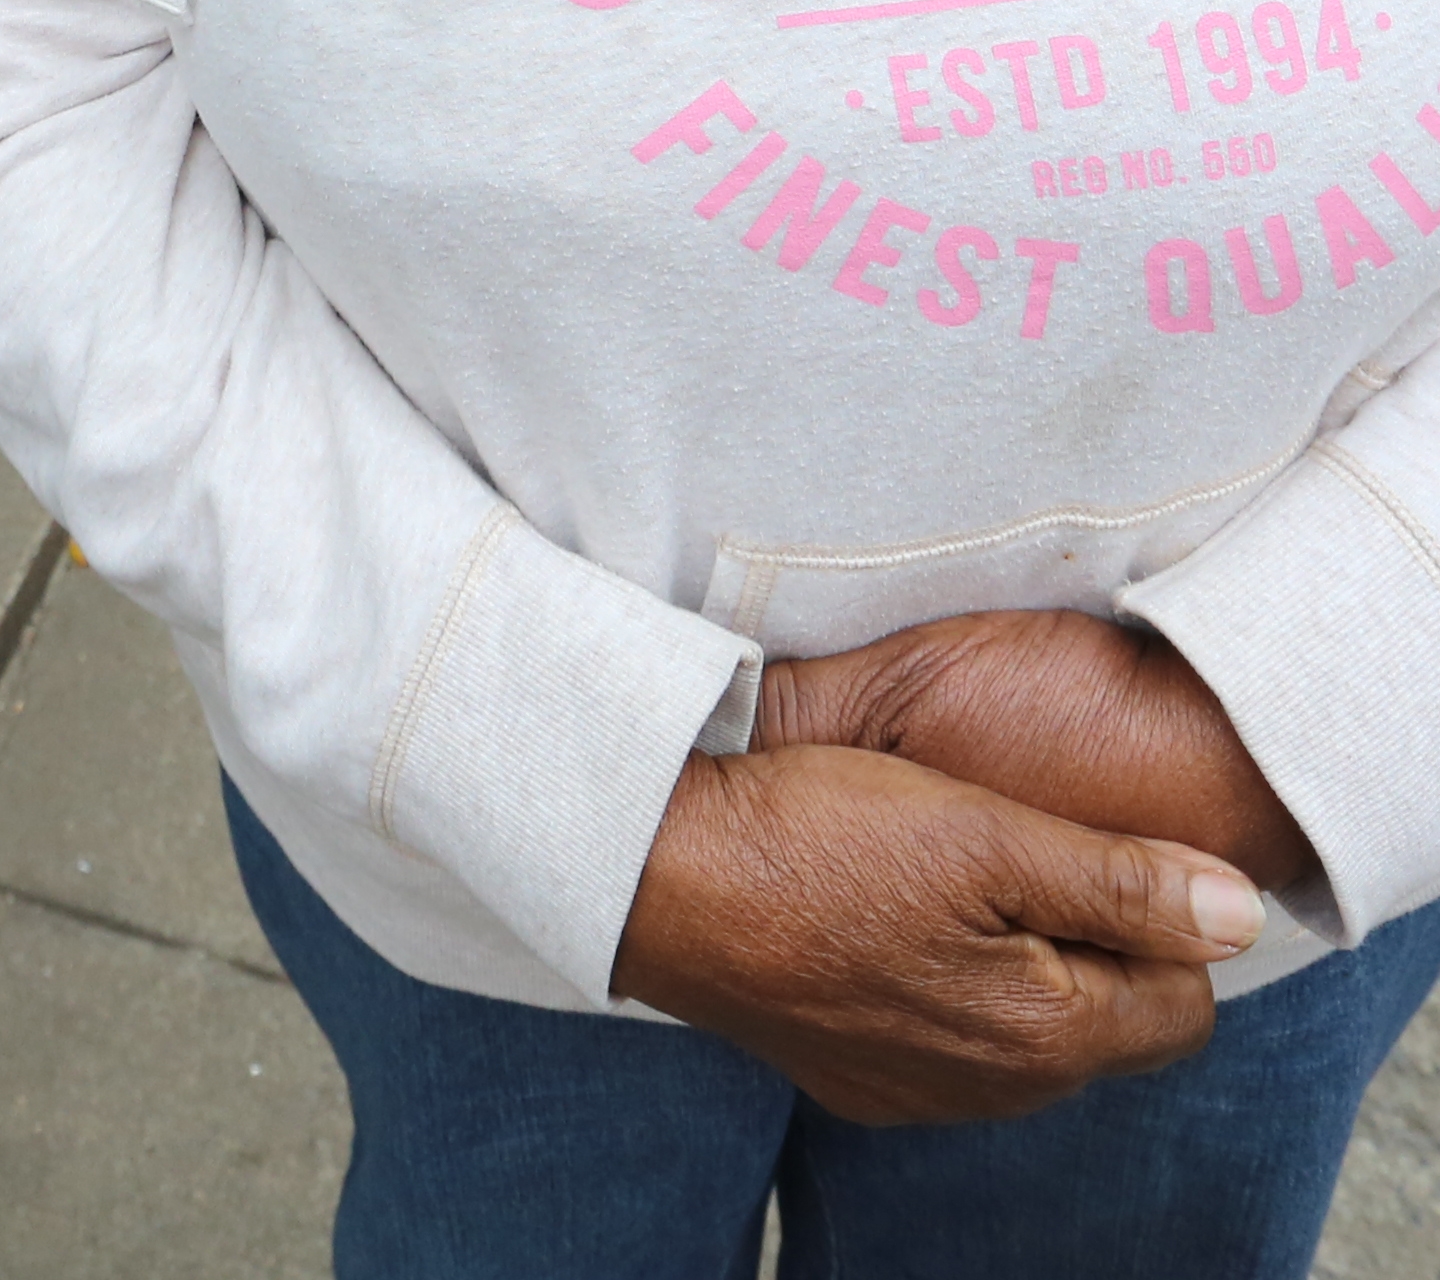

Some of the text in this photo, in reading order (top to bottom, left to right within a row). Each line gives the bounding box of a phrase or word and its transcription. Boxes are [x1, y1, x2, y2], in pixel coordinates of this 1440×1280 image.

[887, 34, 1108, 145] ESTD
[630, 79, 1082, 342] FINEST
[1120, 146, 1190, 191] NO.
